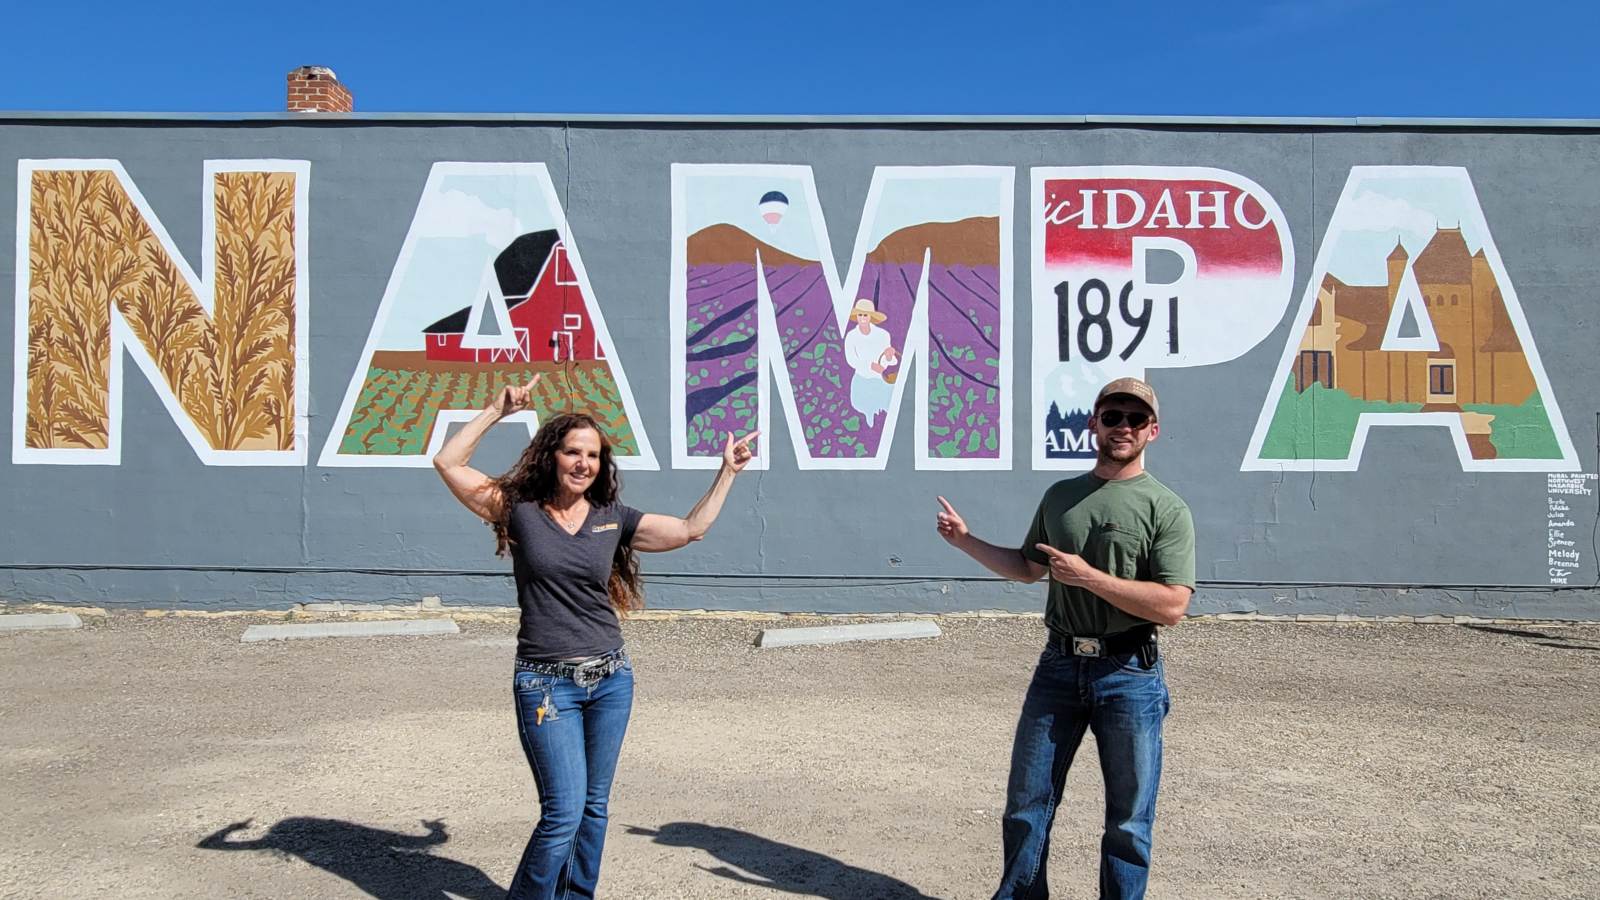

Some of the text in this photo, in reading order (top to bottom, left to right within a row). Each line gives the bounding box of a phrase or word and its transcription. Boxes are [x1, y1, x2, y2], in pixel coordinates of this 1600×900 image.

[1078, 188, 1273, 229] IDAHO
[12, 159, 1580, 473] NAMPA
[1547, 488, 1592, 496] UNIVERSITY
[1548, 519, 1575, 527] Amanda
[1547, 537, 1576, 548] Spencer
[1548, 549, 1580, 562] Melody
